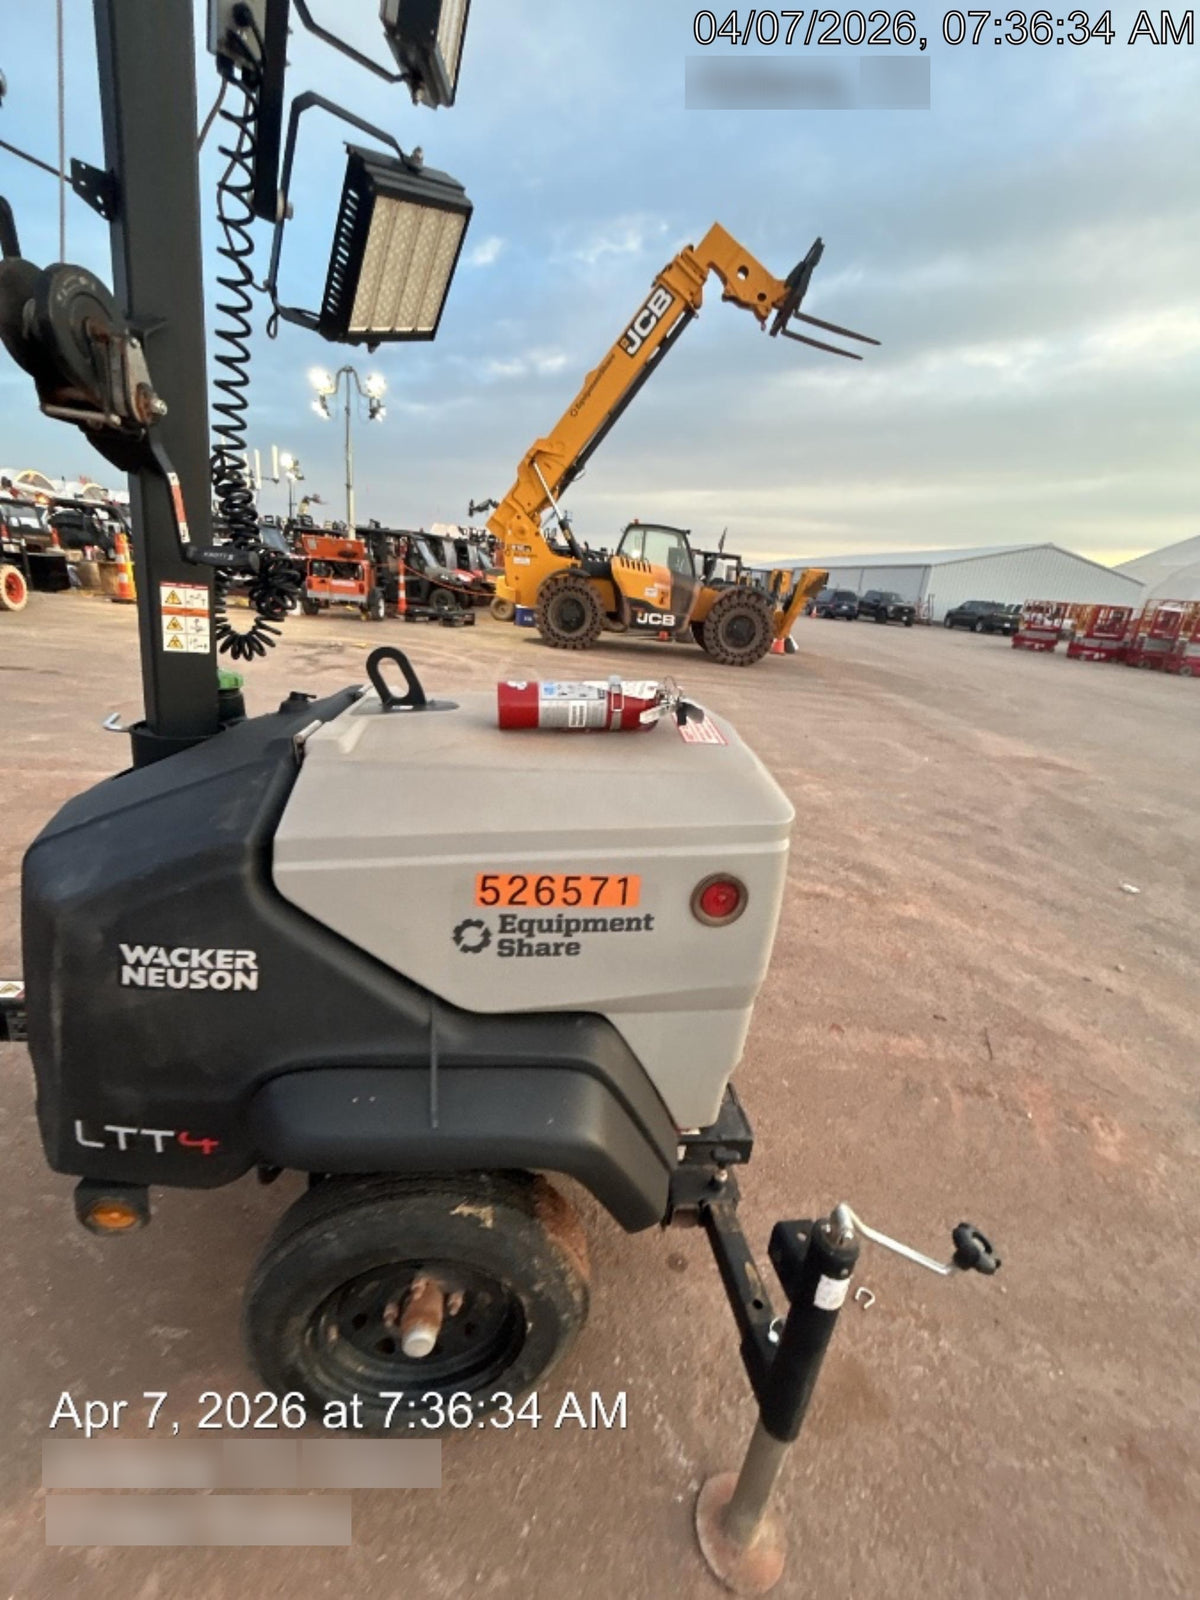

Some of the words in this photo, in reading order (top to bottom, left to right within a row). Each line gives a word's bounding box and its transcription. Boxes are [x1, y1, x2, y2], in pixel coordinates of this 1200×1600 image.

[627, 287, 673, 355] JCB
[637, 612, 675, 627] JCB
[479, 874, 629, 906] 526571
[498, 913, 655, 938] Equipment
[119, 943, 259, 970] WACKER
[497, 938, 581, 957] Share
[121, 965, 259, 991] NEUSON
[75, 1119, 219, 1154] LTT4
